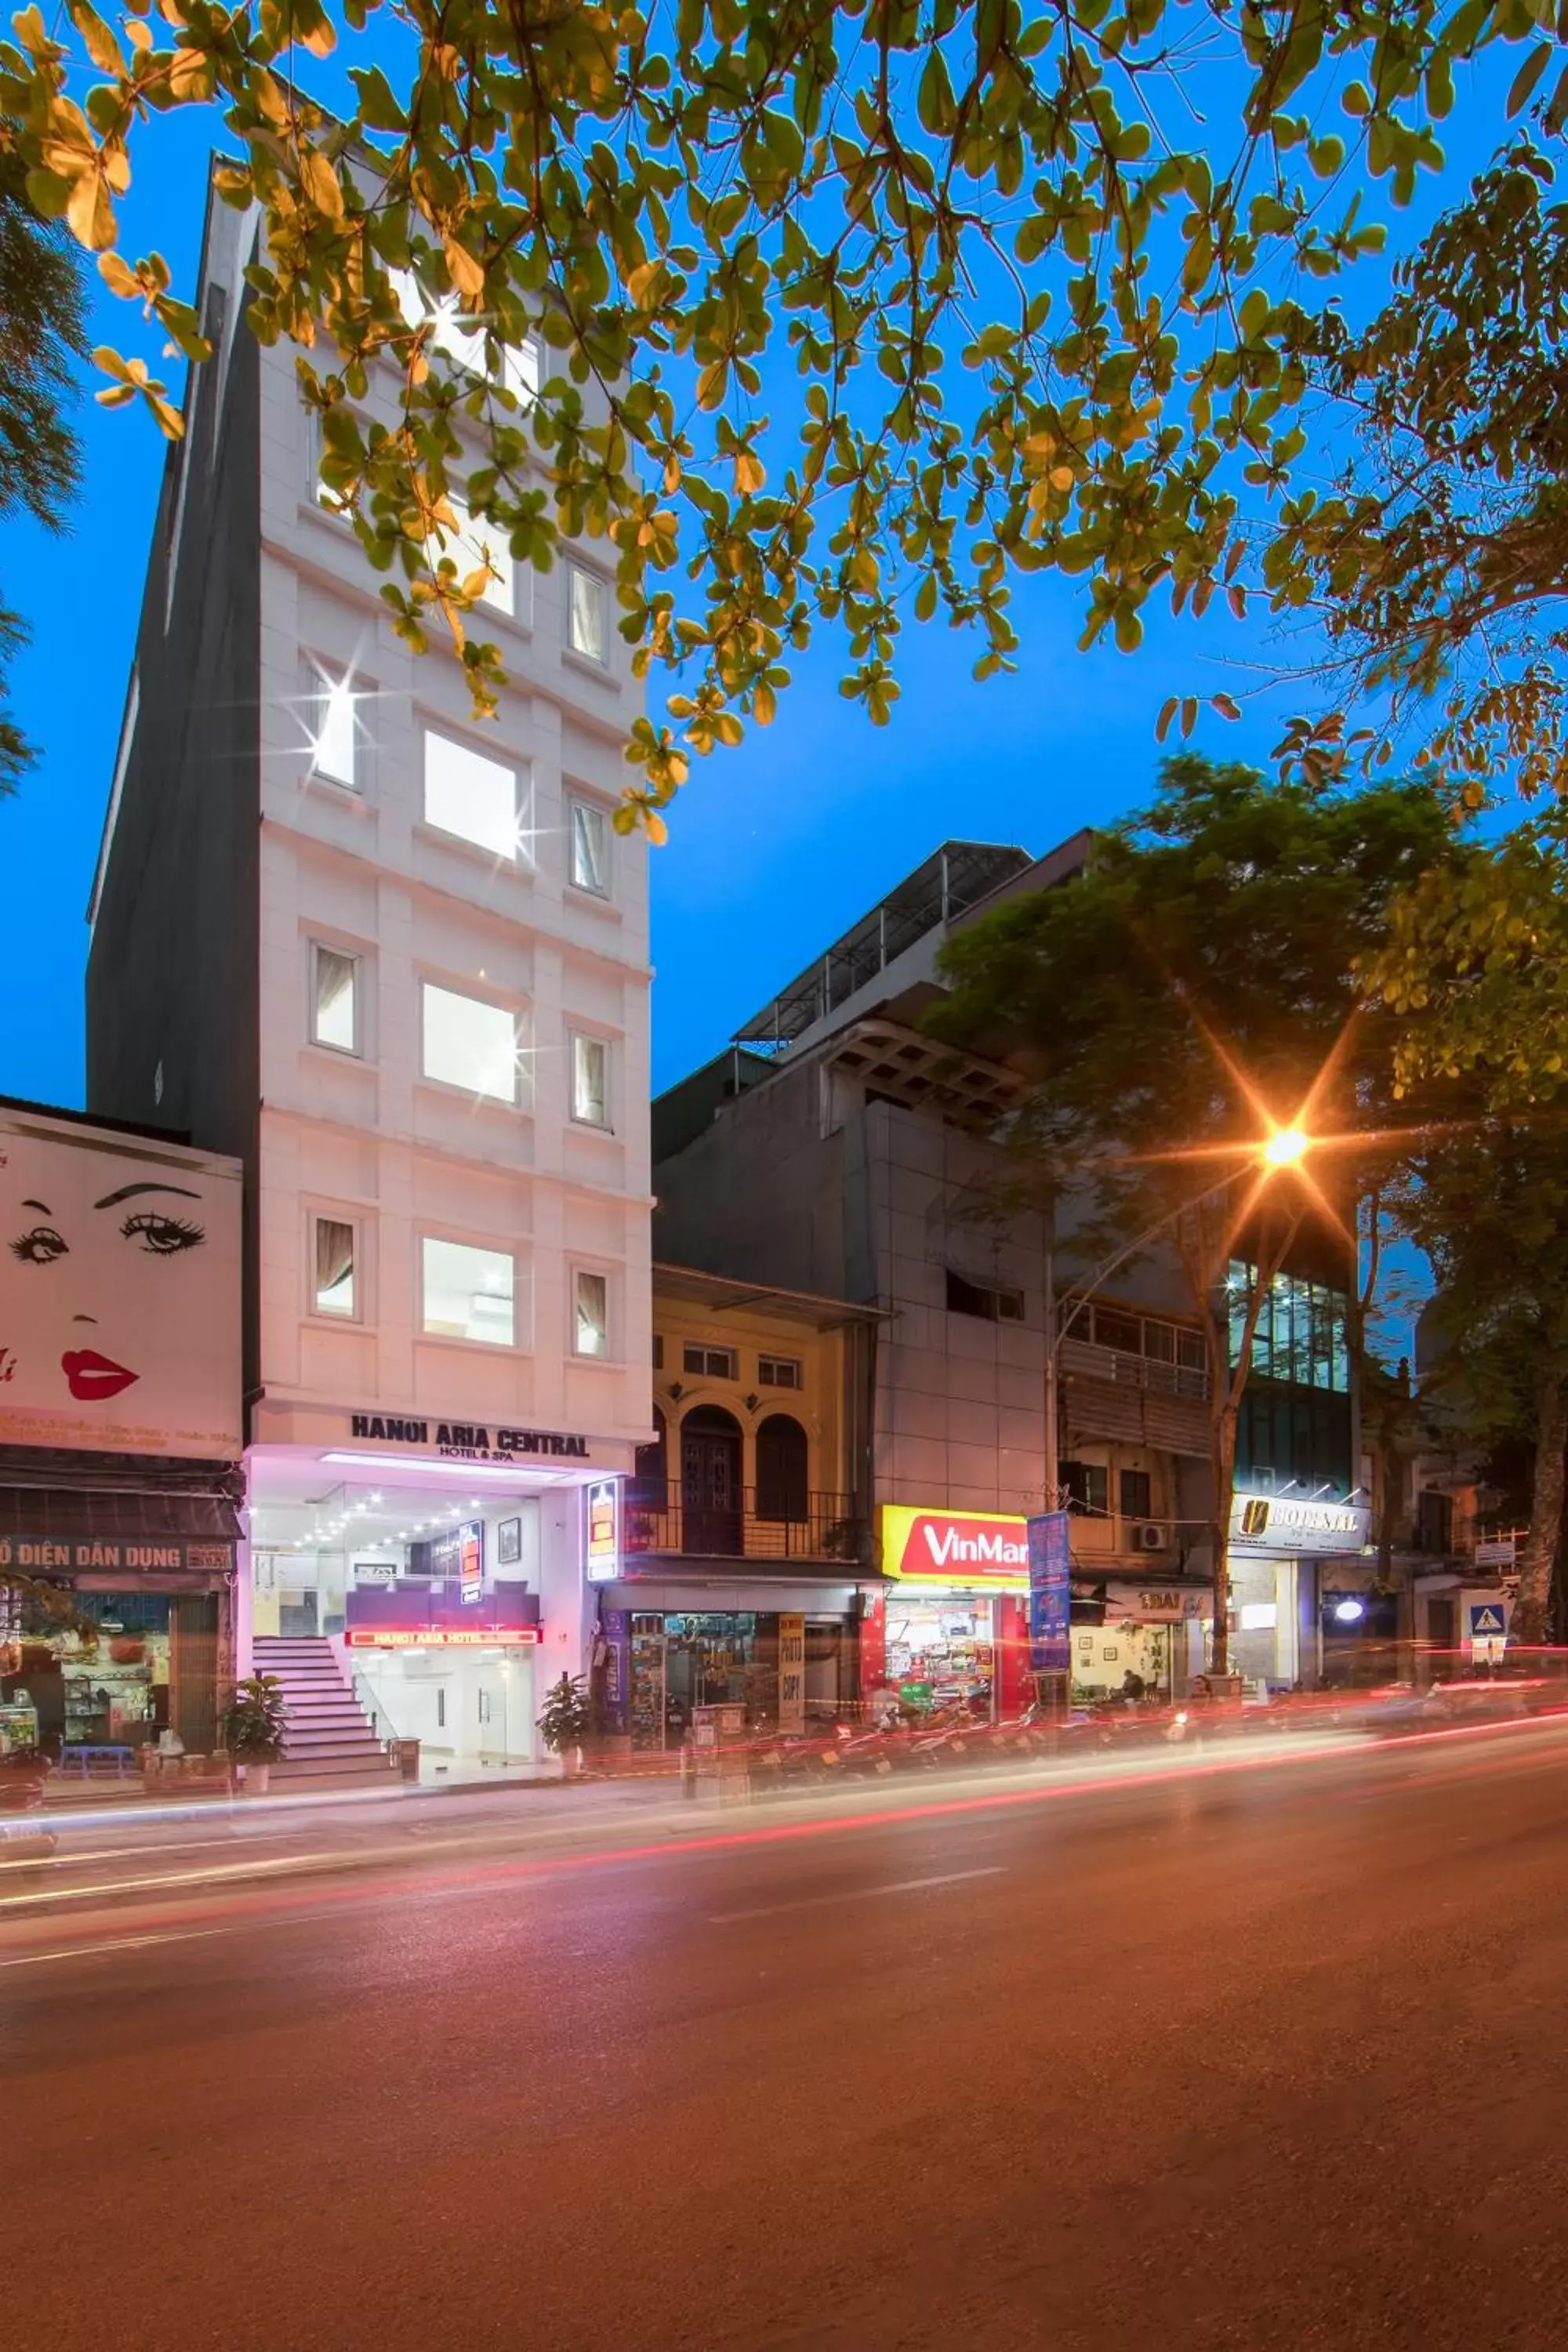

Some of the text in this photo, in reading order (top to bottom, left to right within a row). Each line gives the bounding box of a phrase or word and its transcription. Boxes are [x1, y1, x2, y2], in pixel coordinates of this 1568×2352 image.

[352, 1415, 590, 1457] HANOI ARIA CENTRAL
[440, 1446, 515, 1461] HOTEL & SPA
[126, 1546, 180, 1571] DỤNG
